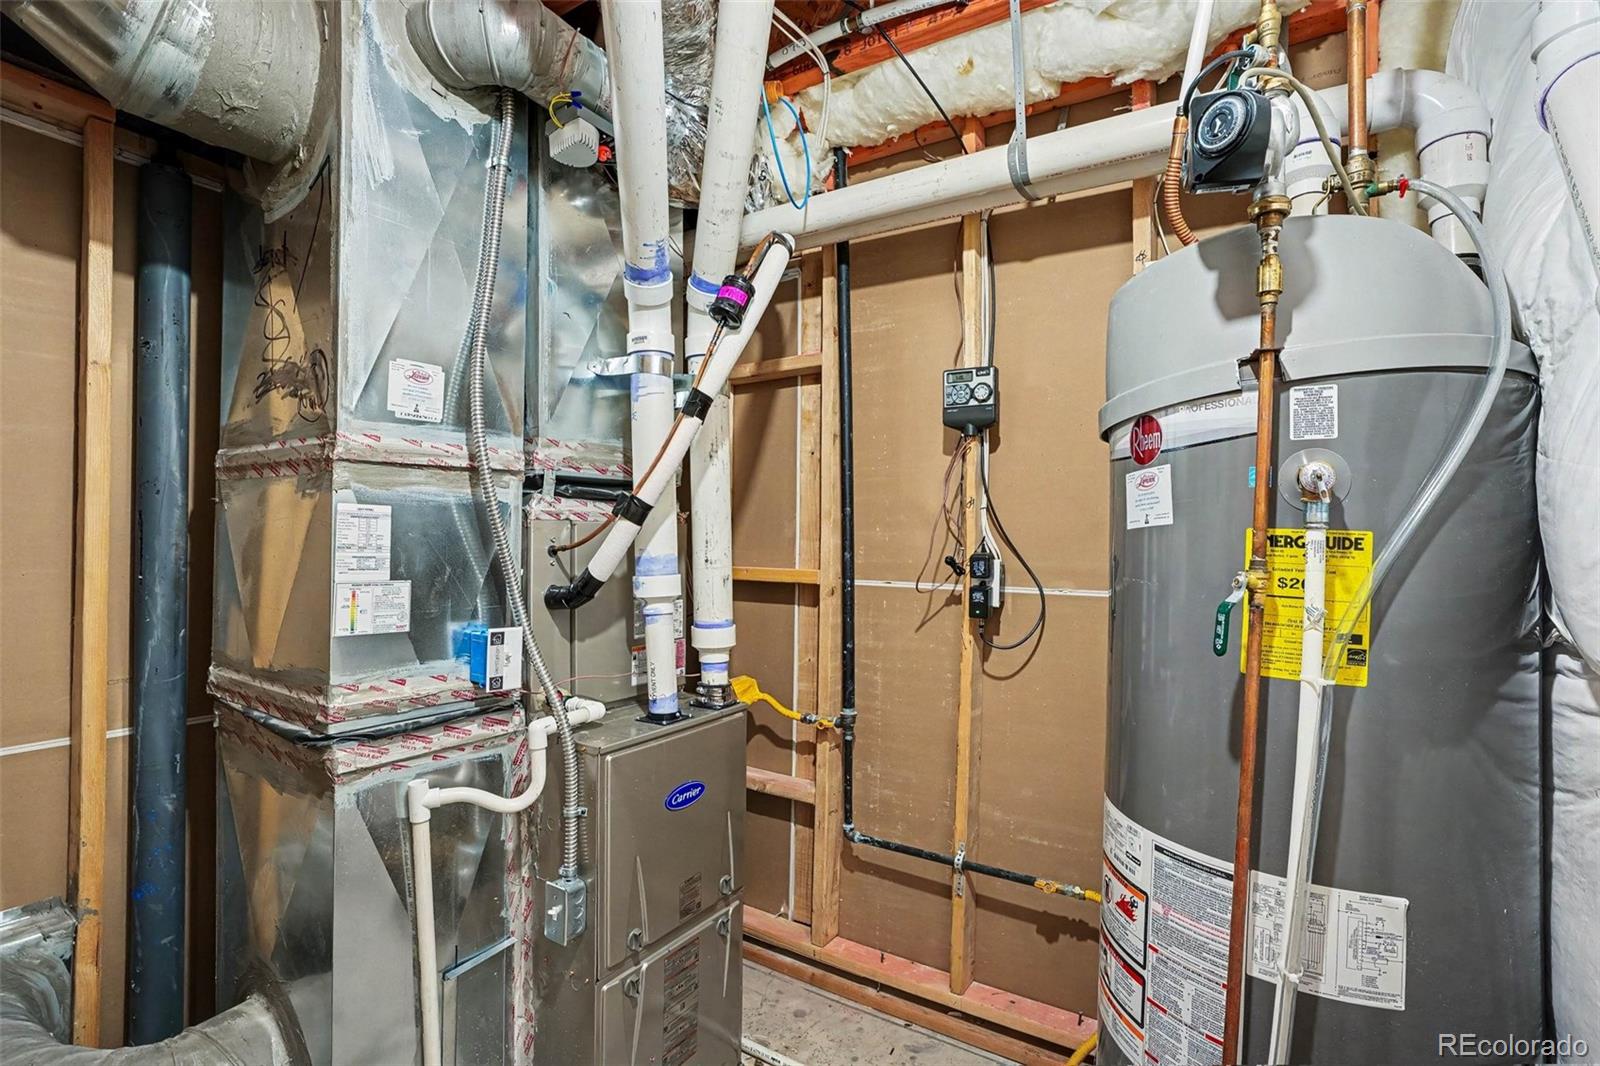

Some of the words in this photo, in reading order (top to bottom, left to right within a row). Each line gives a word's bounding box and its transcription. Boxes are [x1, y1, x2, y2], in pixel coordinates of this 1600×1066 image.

[1132, 417, 1161, 457] Rheem
[1277, 577, 1305, 591] $2
[671, 786, 702, 806] Carrier
